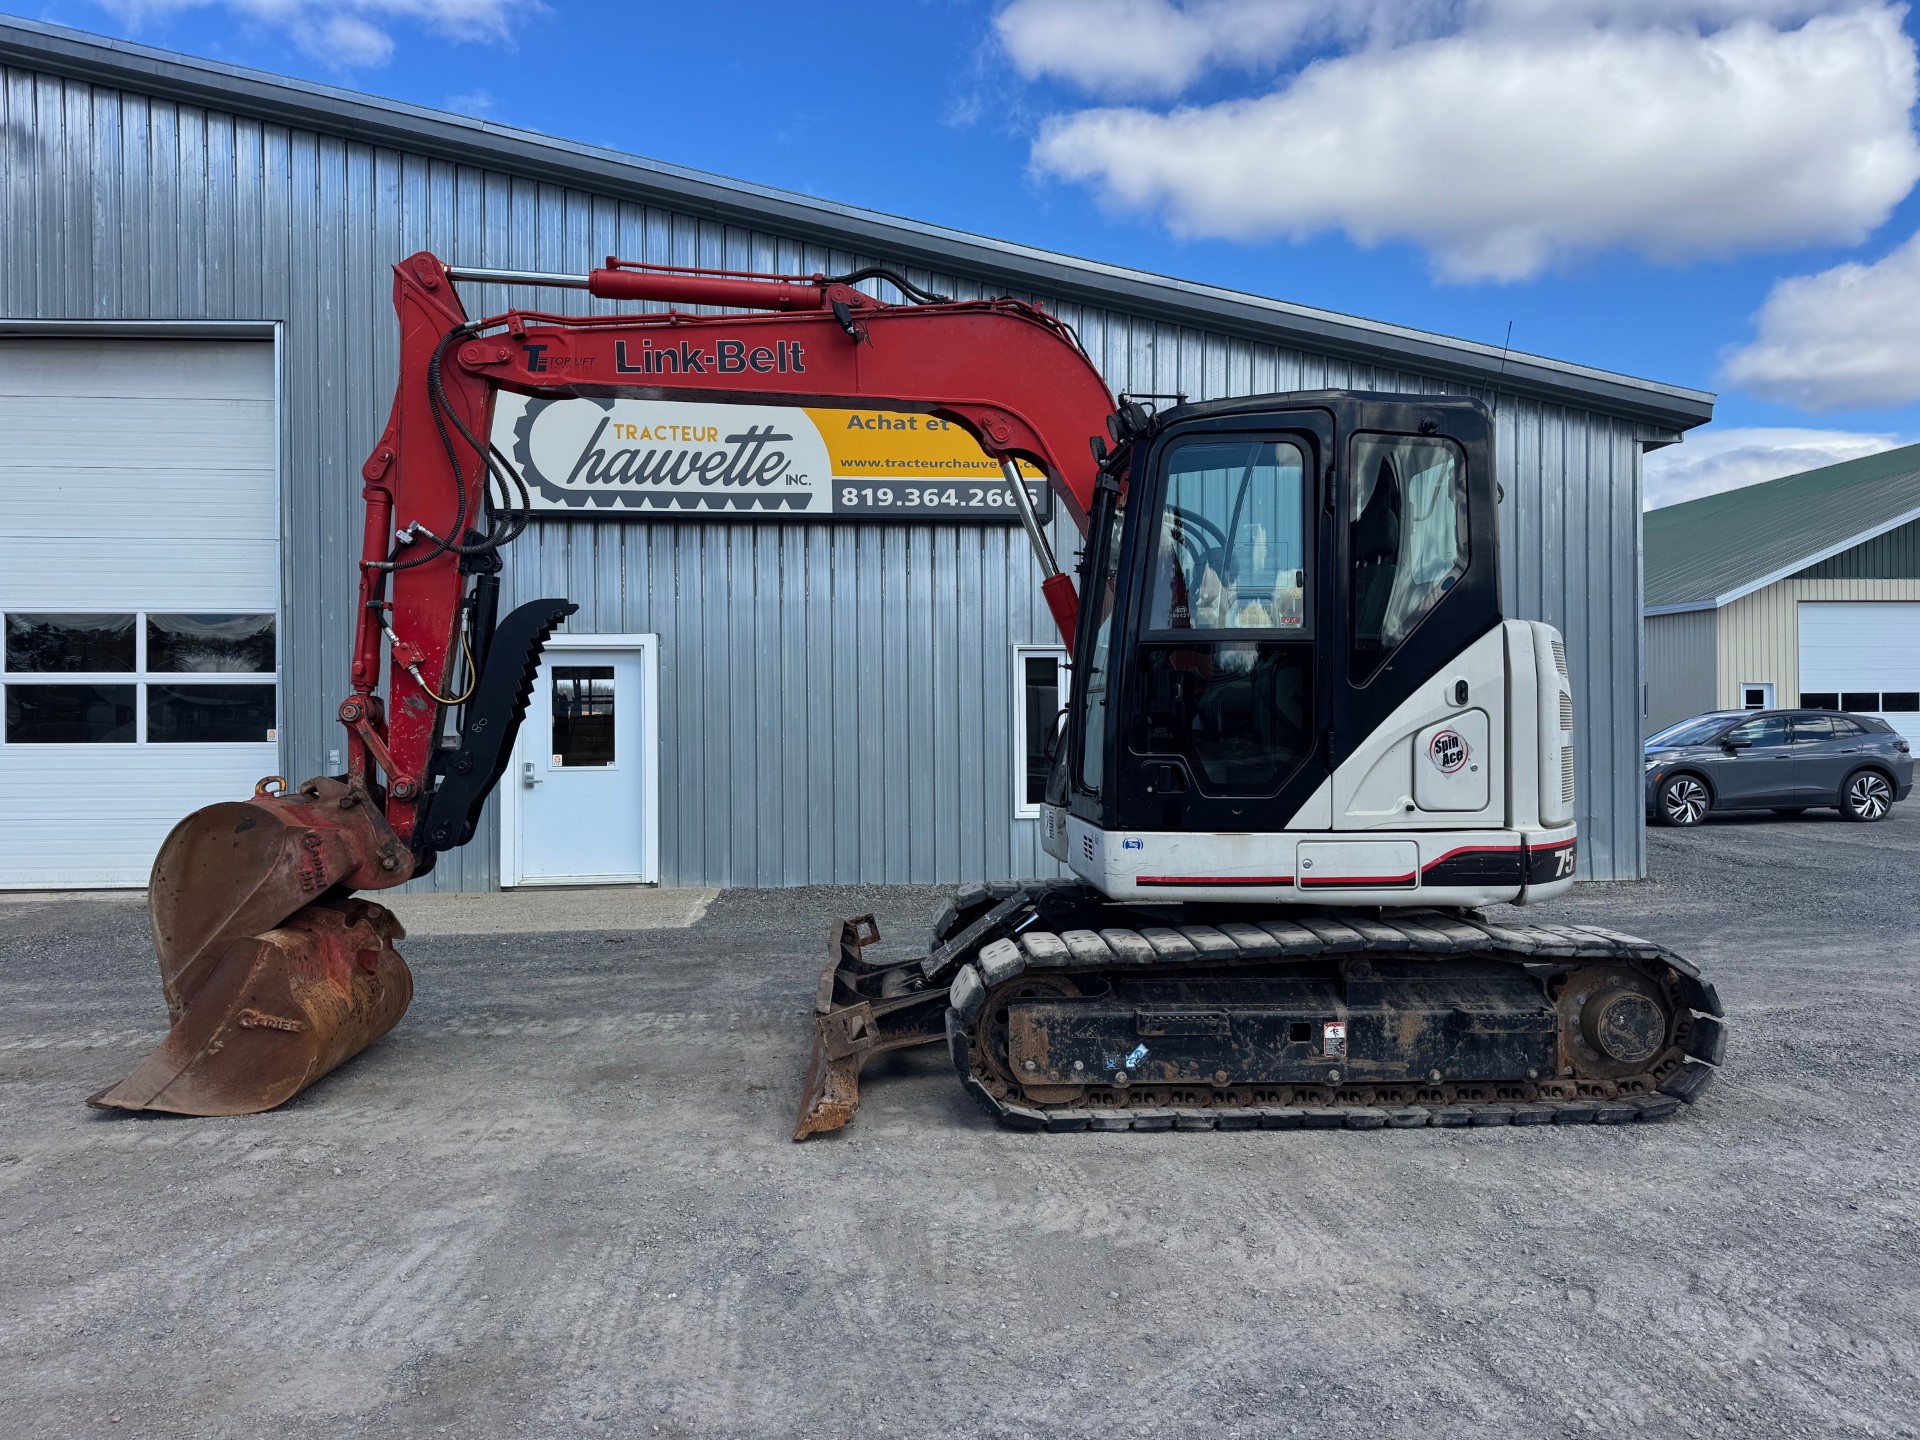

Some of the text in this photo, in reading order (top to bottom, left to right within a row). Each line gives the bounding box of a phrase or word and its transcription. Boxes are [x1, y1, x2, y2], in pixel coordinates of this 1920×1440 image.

[549, 356, 596, 367] TOP LIFT
[615, 339, 806, 375] Link-Belt
[846, 414, 950, 431] Achat et
[613, 423, 719, 443] TRACTEUR
[785, 473, 812, 487] INC.
[1434, 736, 1459, 755] Spin
[1442, 749, 1464, 767] Ace
